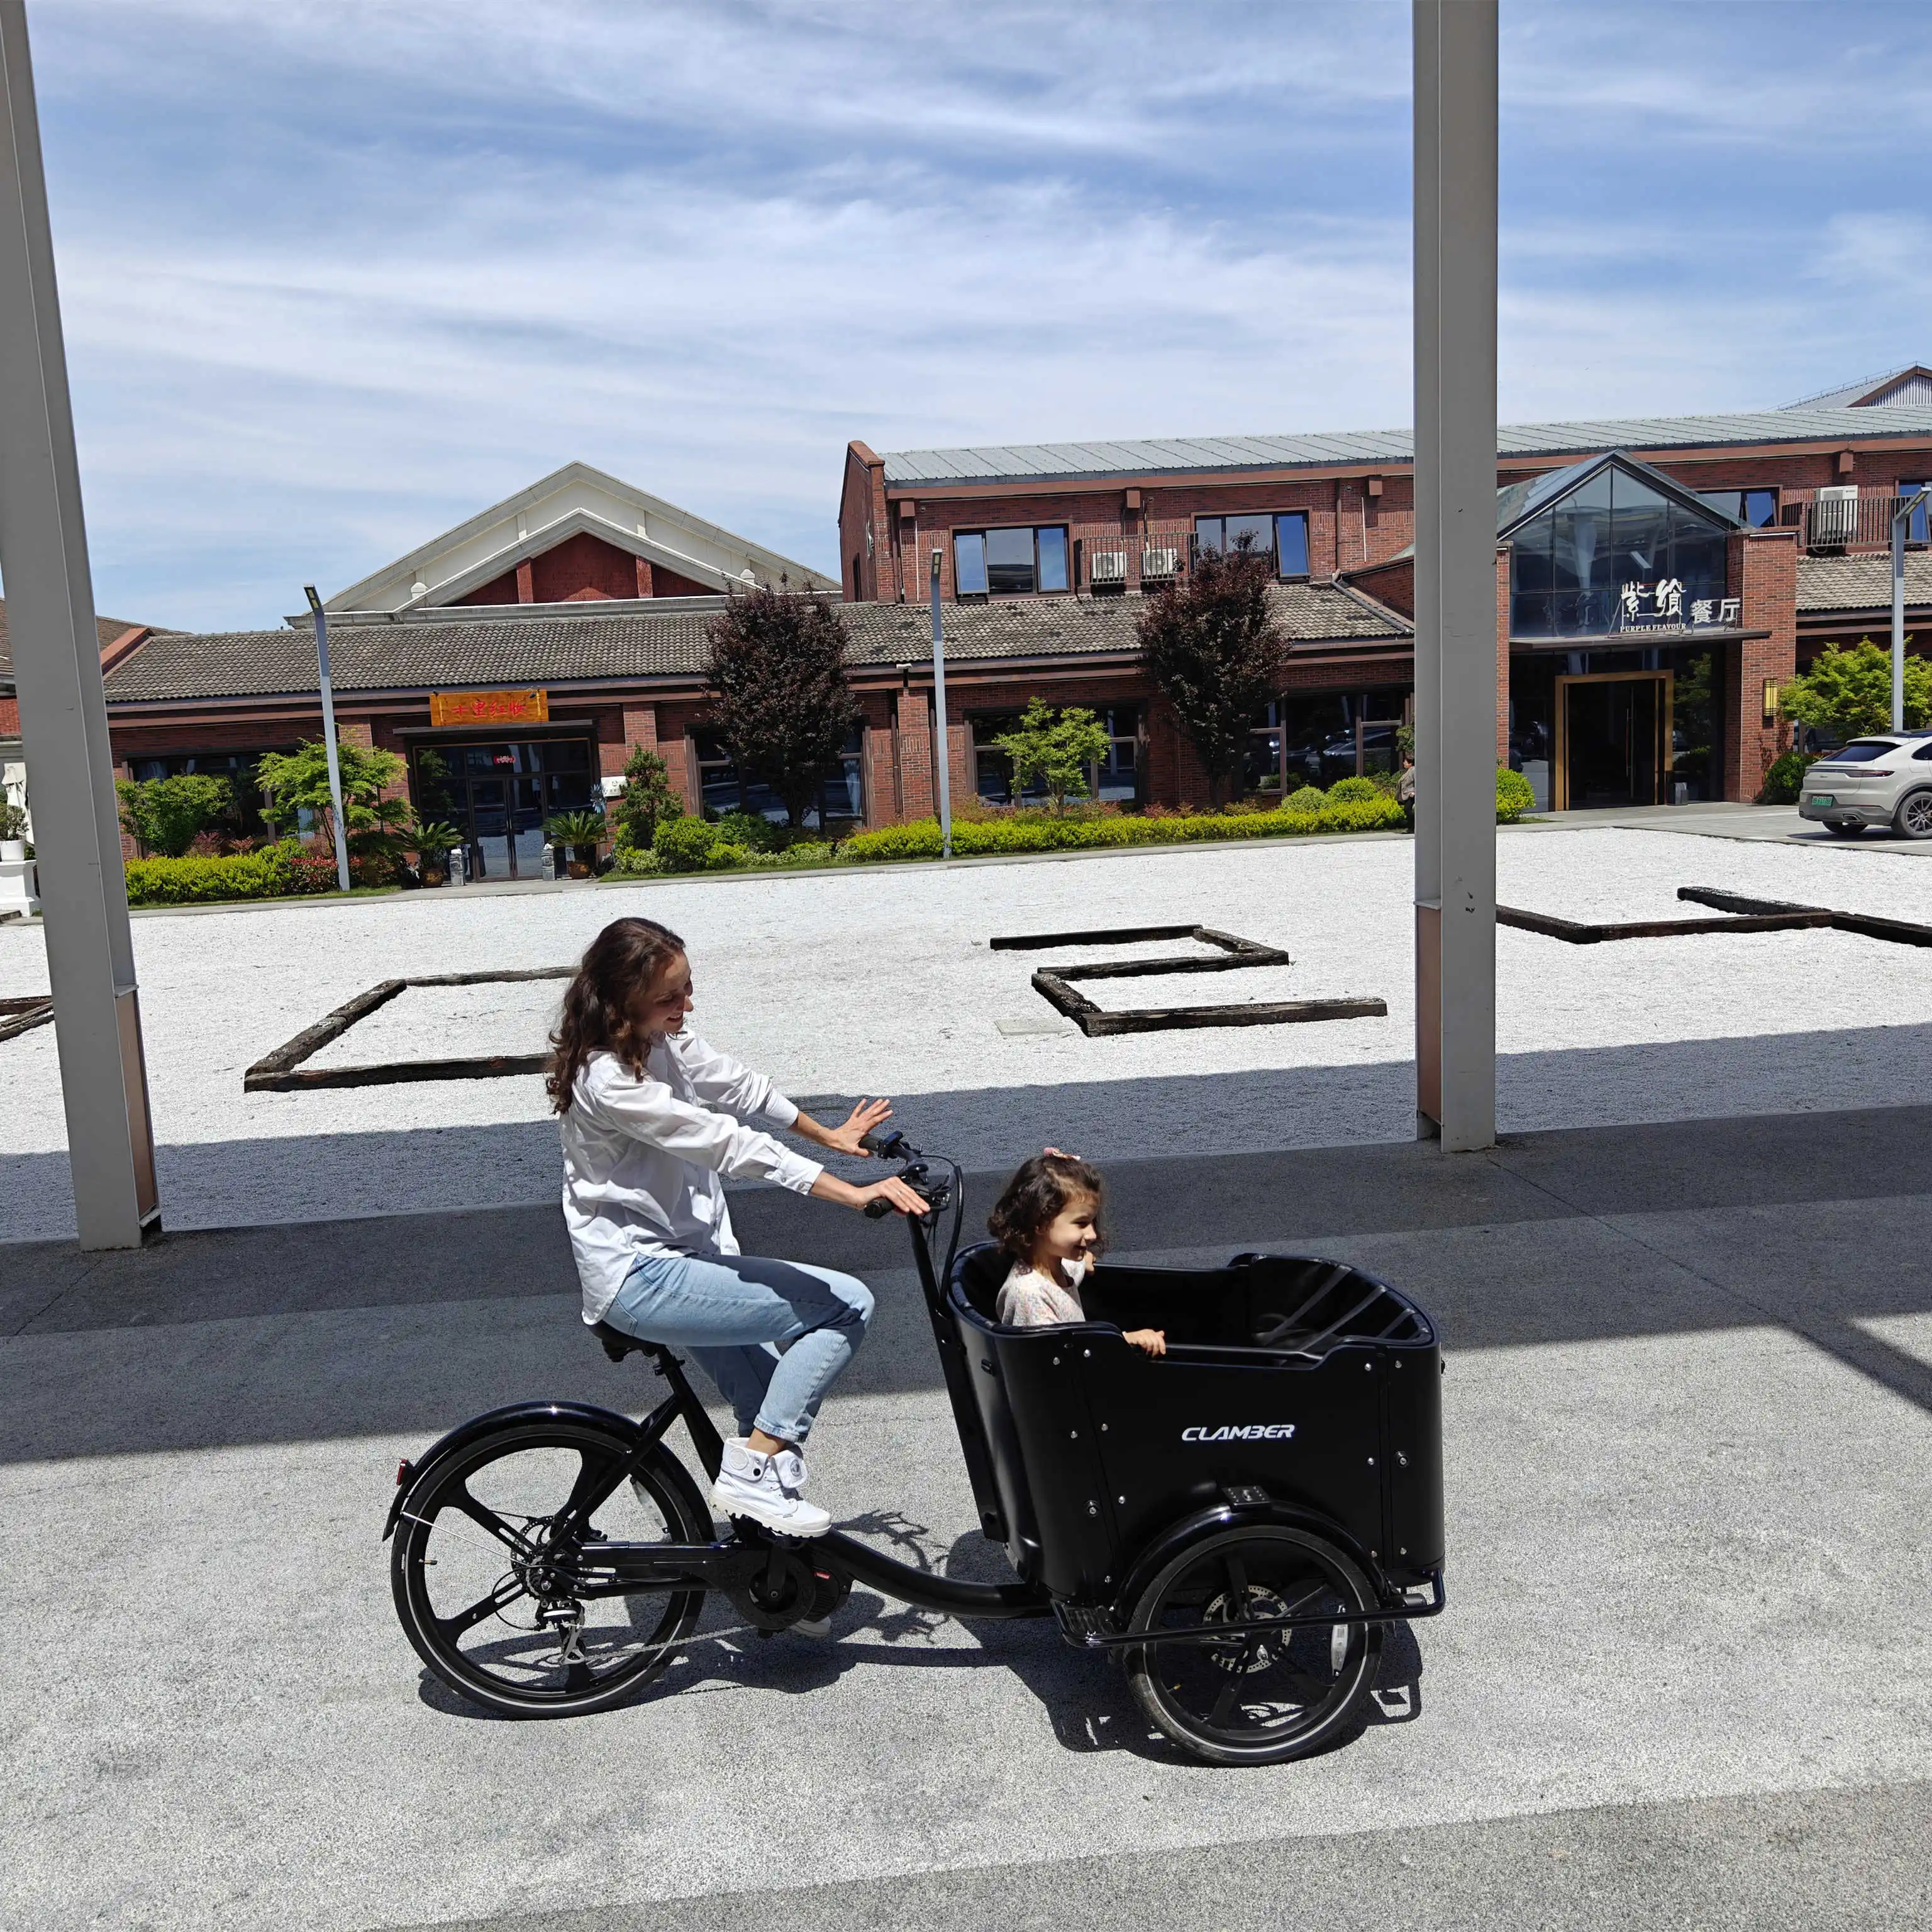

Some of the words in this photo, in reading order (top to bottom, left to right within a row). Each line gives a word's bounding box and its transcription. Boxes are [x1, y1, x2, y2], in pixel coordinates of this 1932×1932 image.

[1620, 625, 1651, 633] PURPLE
[1652, 623, 1686, 631] FLAVOUR
[1181, 1424, 1296, 1441] CLAMBER
